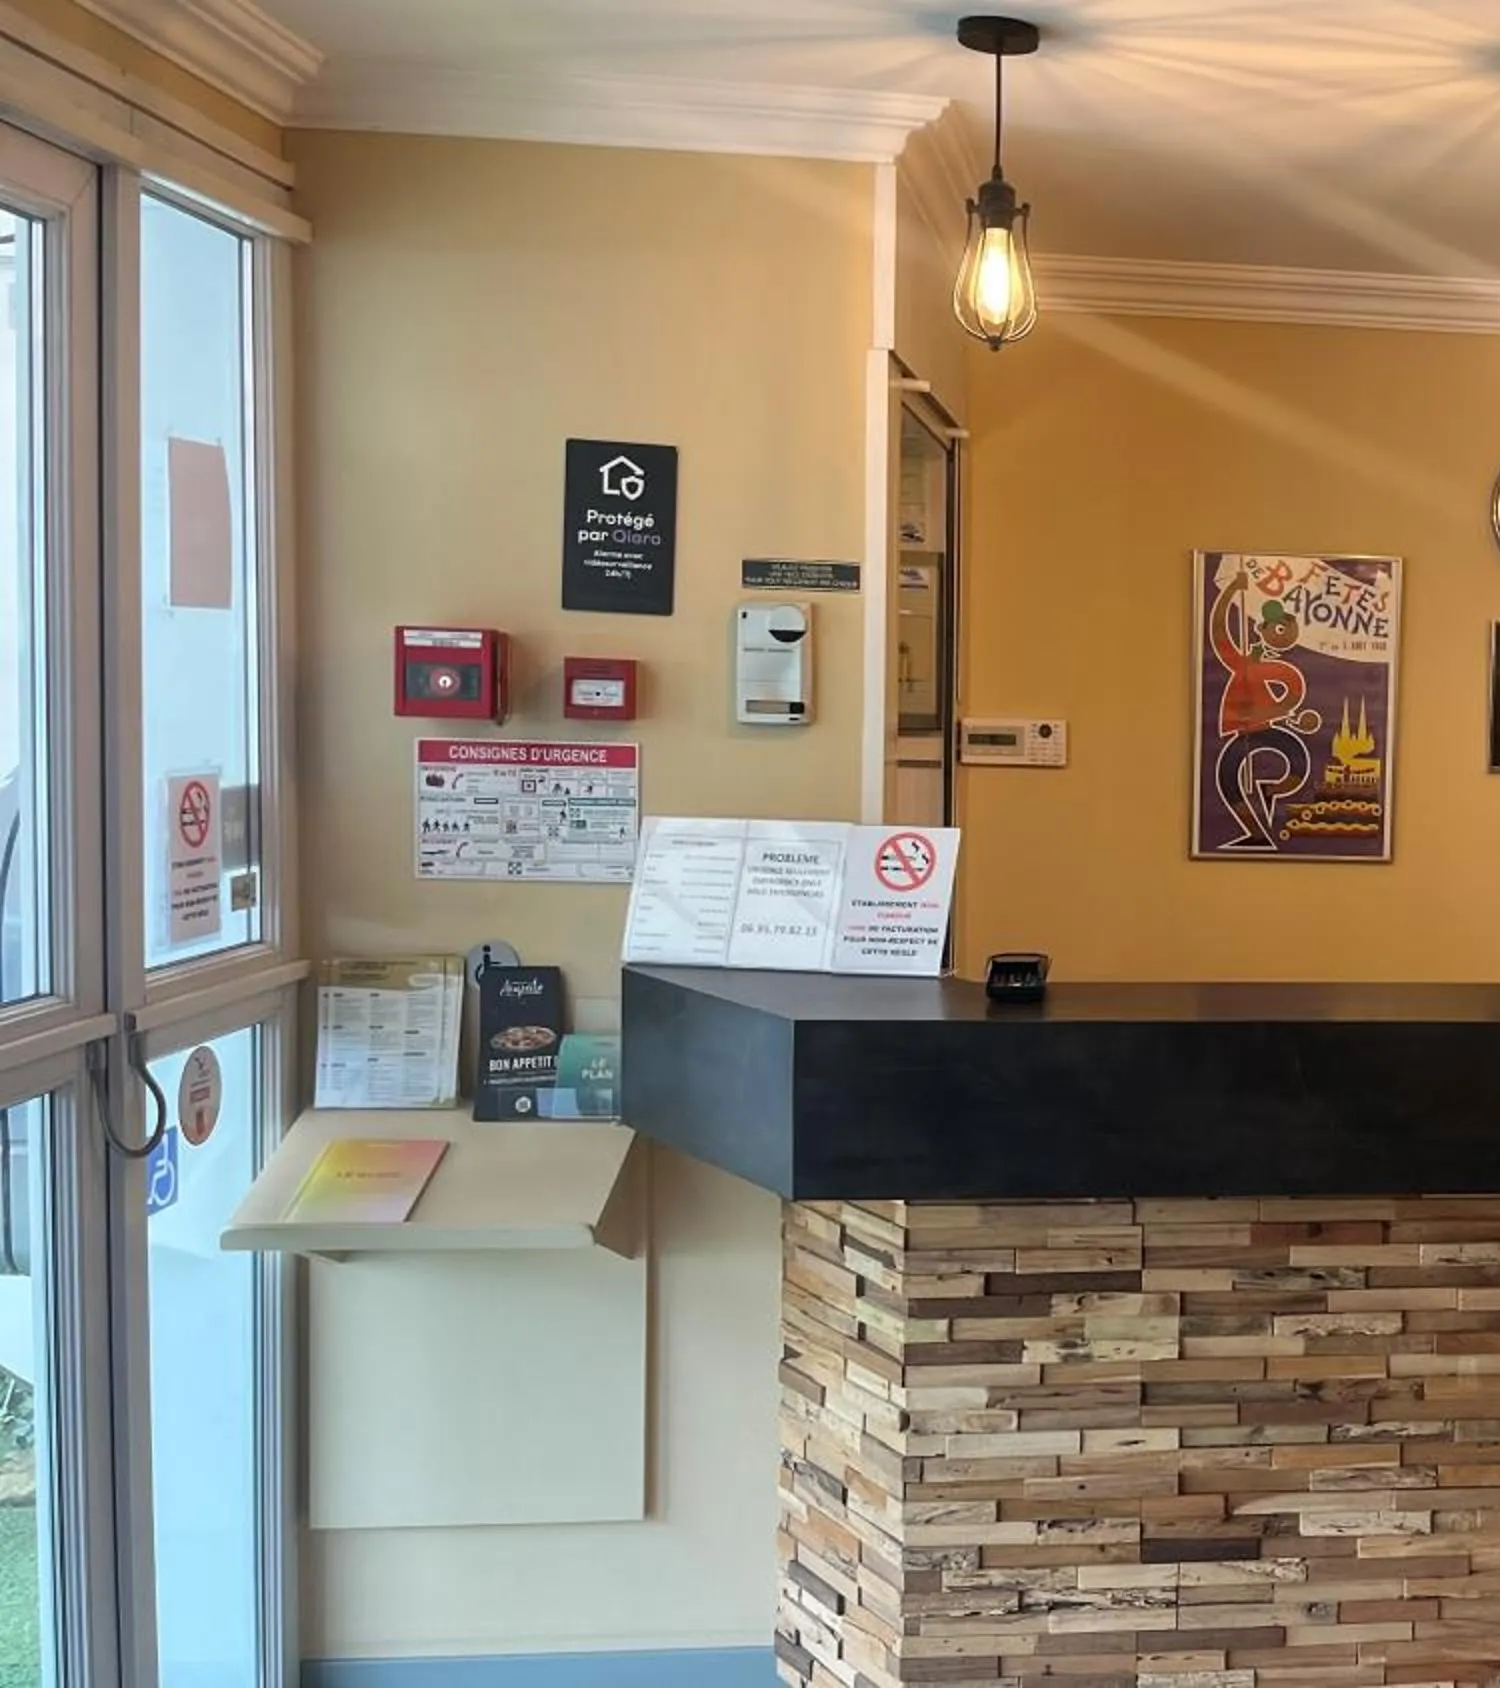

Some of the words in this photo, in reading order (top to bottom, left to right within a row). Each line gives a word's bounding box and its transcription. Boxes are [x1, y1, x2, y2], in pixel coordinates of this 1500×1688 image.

[587, 509, 655, 530] Protégé
[577, 529, 609, 544] par
[1246, 559, 1262, 579] DE
[449, 745, 527, 761] CONSIGNES
[531, 747, 607, 763] D'URGENCE
[489, 1058, 511, 1073] BON
[581, 1068, 614, 1080] PLAN
